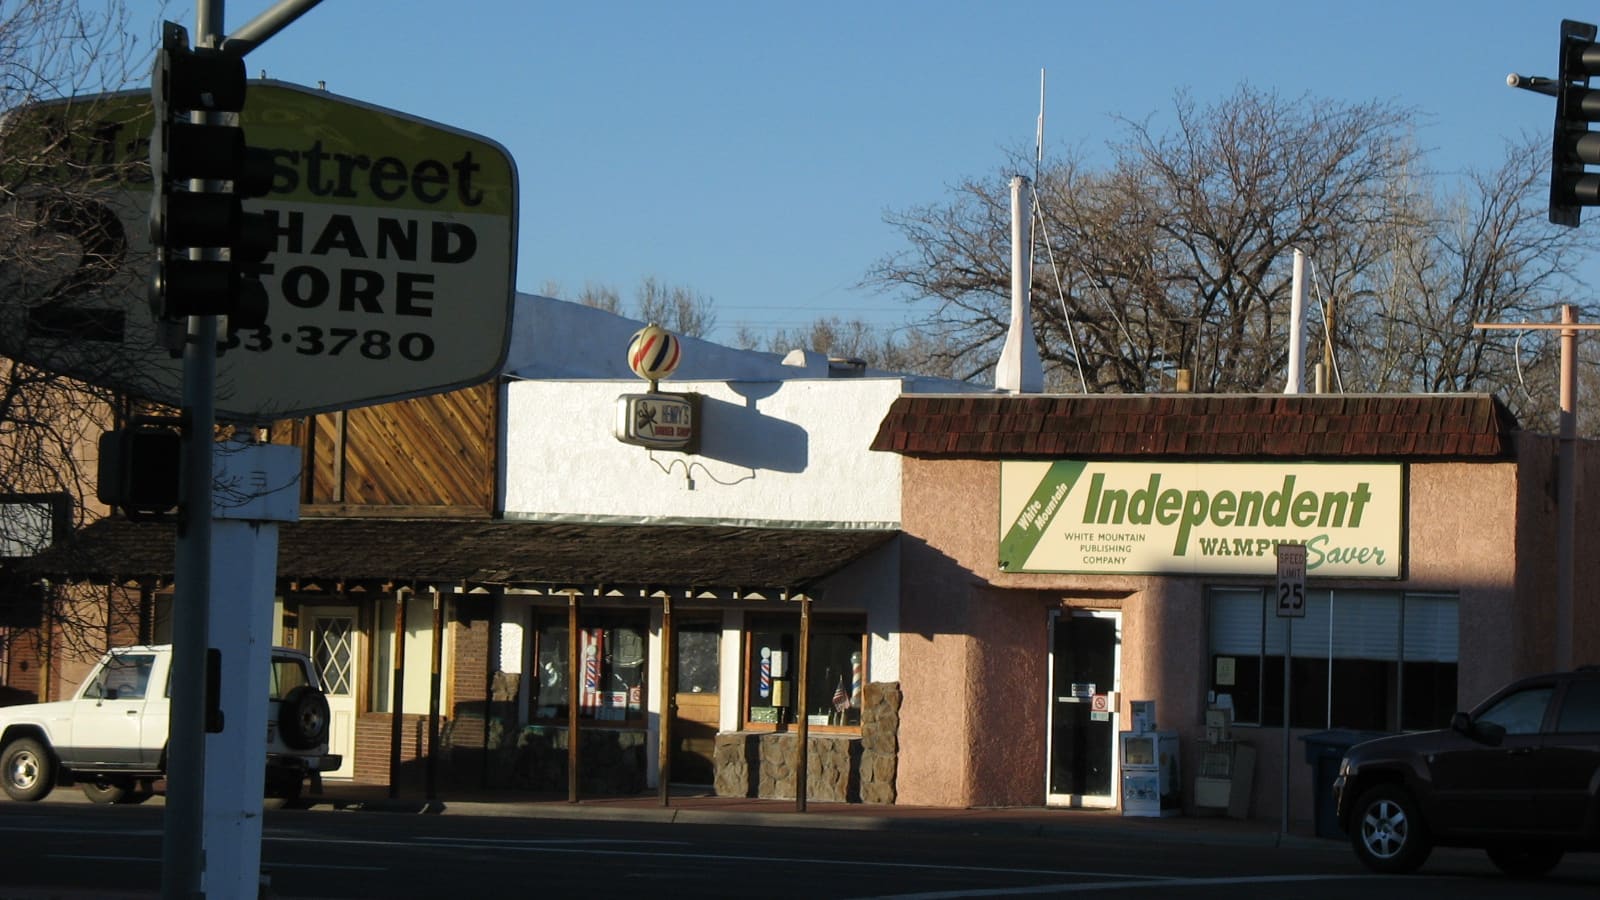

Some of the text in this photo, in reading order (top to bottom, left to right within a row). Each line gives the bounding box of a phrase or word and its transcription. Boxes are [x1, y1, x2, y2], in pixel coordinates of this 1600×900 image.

[264, 210, 477, 263] HAND
[1017, 500, 1041, 531] White
[1033, 482, 1068, 532] Mountain
[1082, 473, 1371, 556] Independent
[1064, 532, 1146, 542] WHITE MOUNTAIN
[1080, 544, 1132, 553] PUBLISHING
[1082, 556, 1127, 565] COMPANY
[1279, 552, 1304, 565] SPEED
[1305, 534, 1386, 570] Saver
[1281, 568, 1302, 578] LIMIT
[1279, 582, 1303, 609] 25
